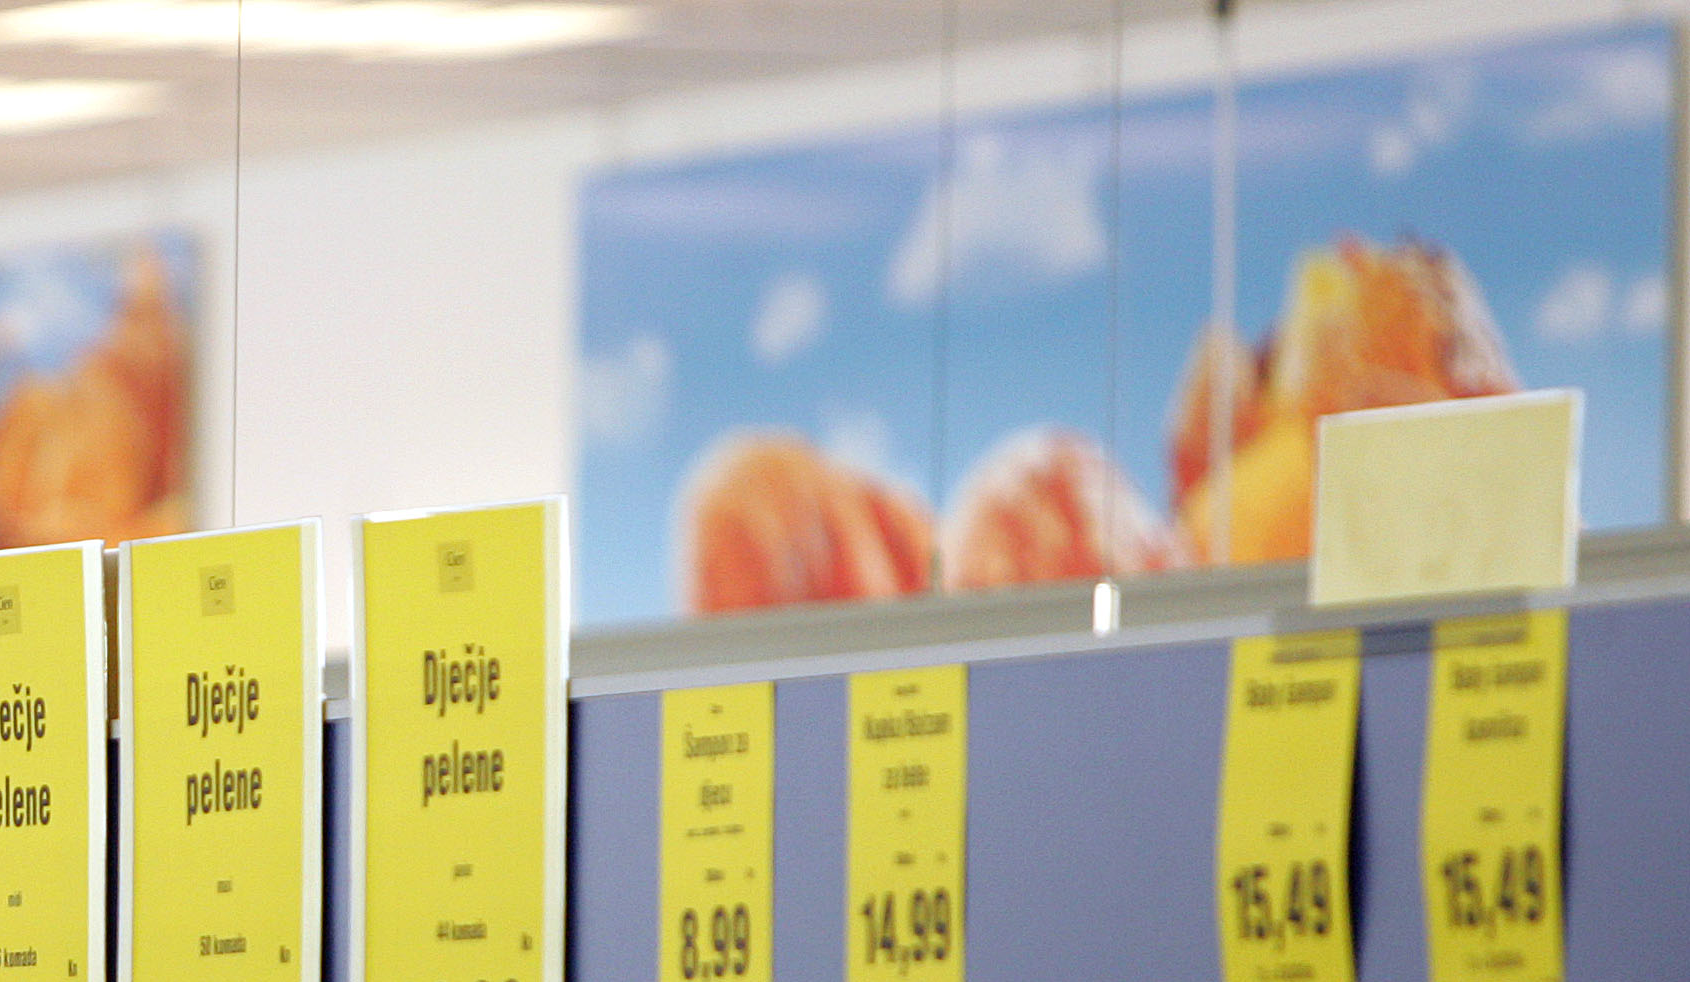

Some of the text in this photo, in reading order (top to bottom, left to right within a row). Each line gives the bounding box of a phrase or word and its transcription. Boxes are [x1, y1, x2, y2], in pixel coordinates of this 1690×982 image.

[186, 664, 259, 738] Dječje
[423, 642, 501, 717] Dječje
[186, 758, 263, 827] pelene
[422, 739, 505, 808] pelene
[1233, 859, 1333, 954] 15,49
[1441, 844, 1546, 938] 15,49
[4, 946, 37, 968] komada
[862, 887, 951, 977] 14,99
